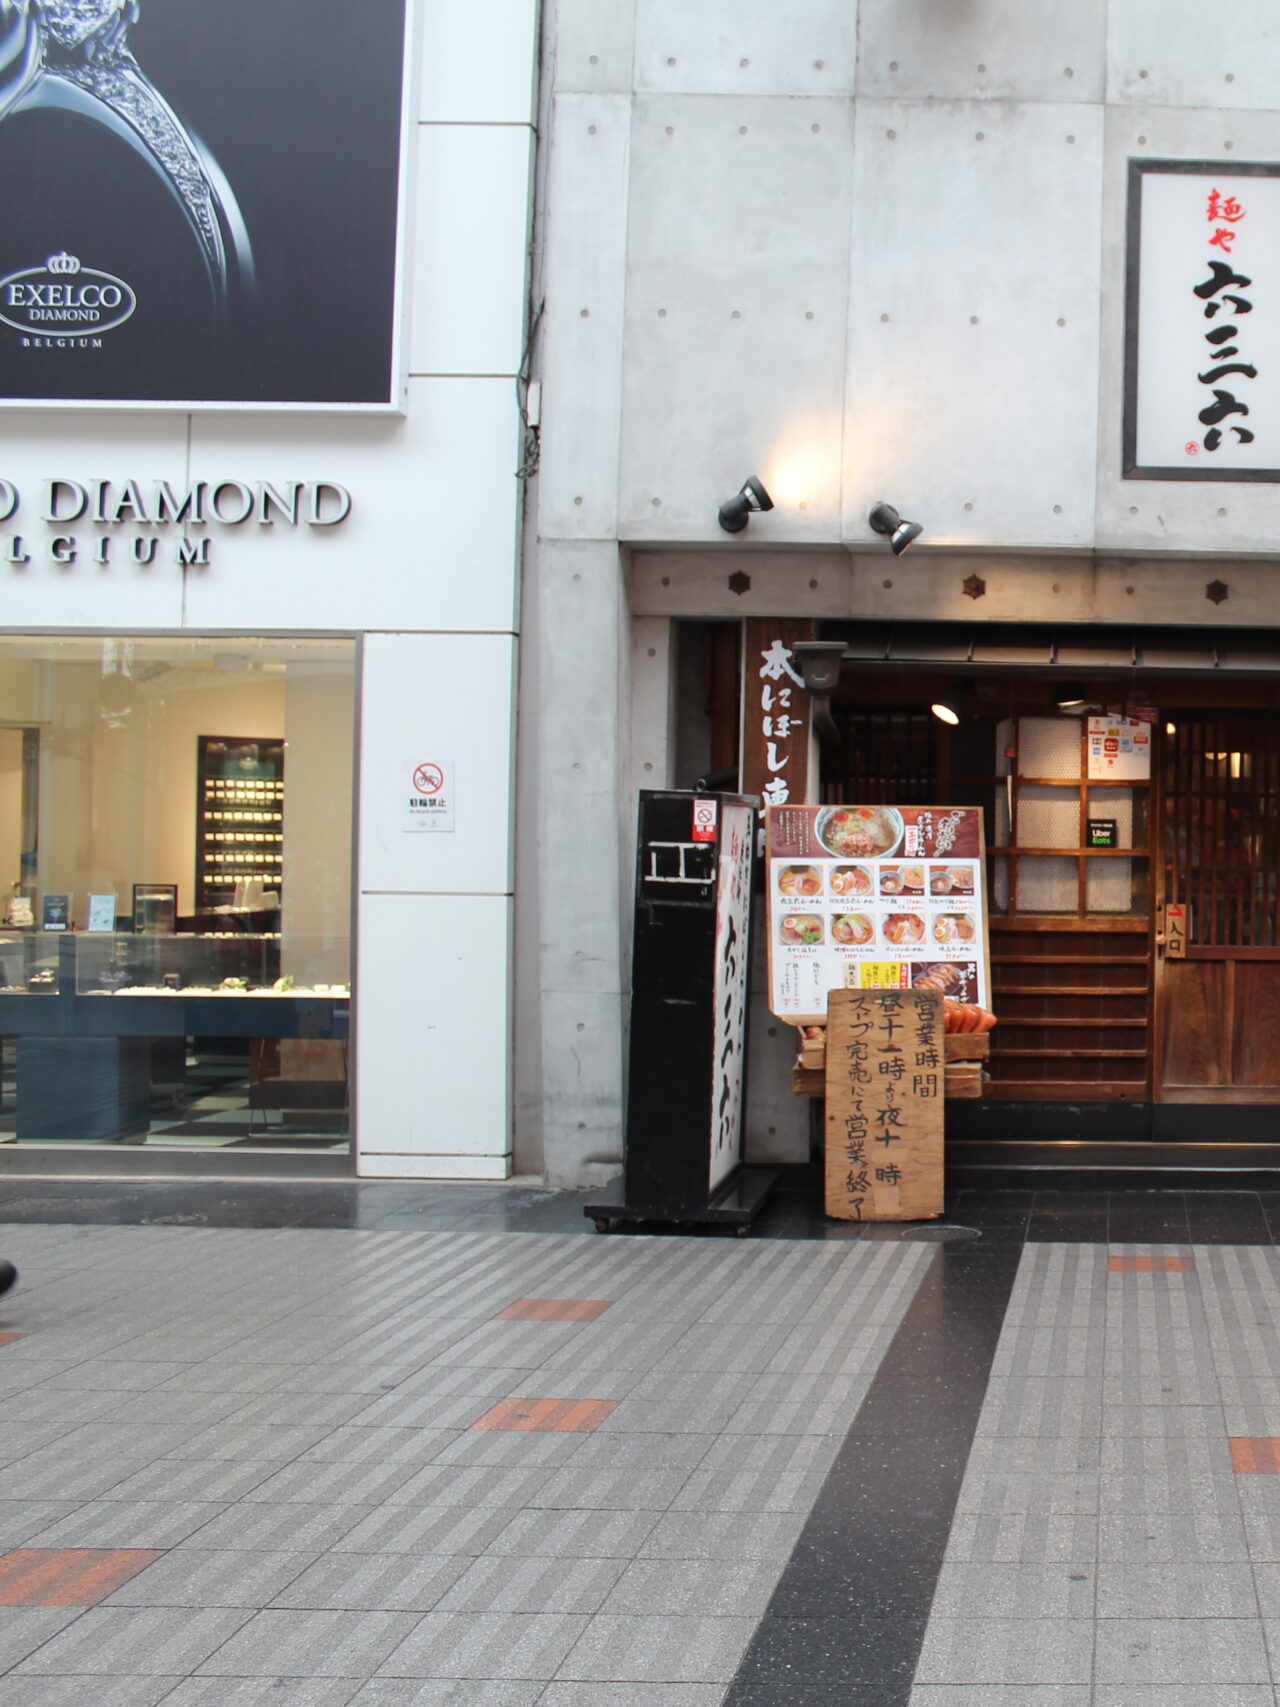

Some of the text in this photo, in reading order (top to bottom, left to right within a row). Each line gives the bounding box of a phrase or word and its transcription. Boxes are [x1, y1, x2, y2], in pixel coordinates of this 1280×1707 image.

[8, 284, 122, 308] EXELCO
[29, 308, 100, 322] DIAMOND
[23, 337, 102, 348] BELGIUM
[41, 478, 352, 525] DIAMOND
[5, 535, 211, 564] LGIUM
[1092, 829, 1110, 837] Uber
[1169, 922, 1183, 951] 入口
[913, 993, 940, 1098] 営業時間
